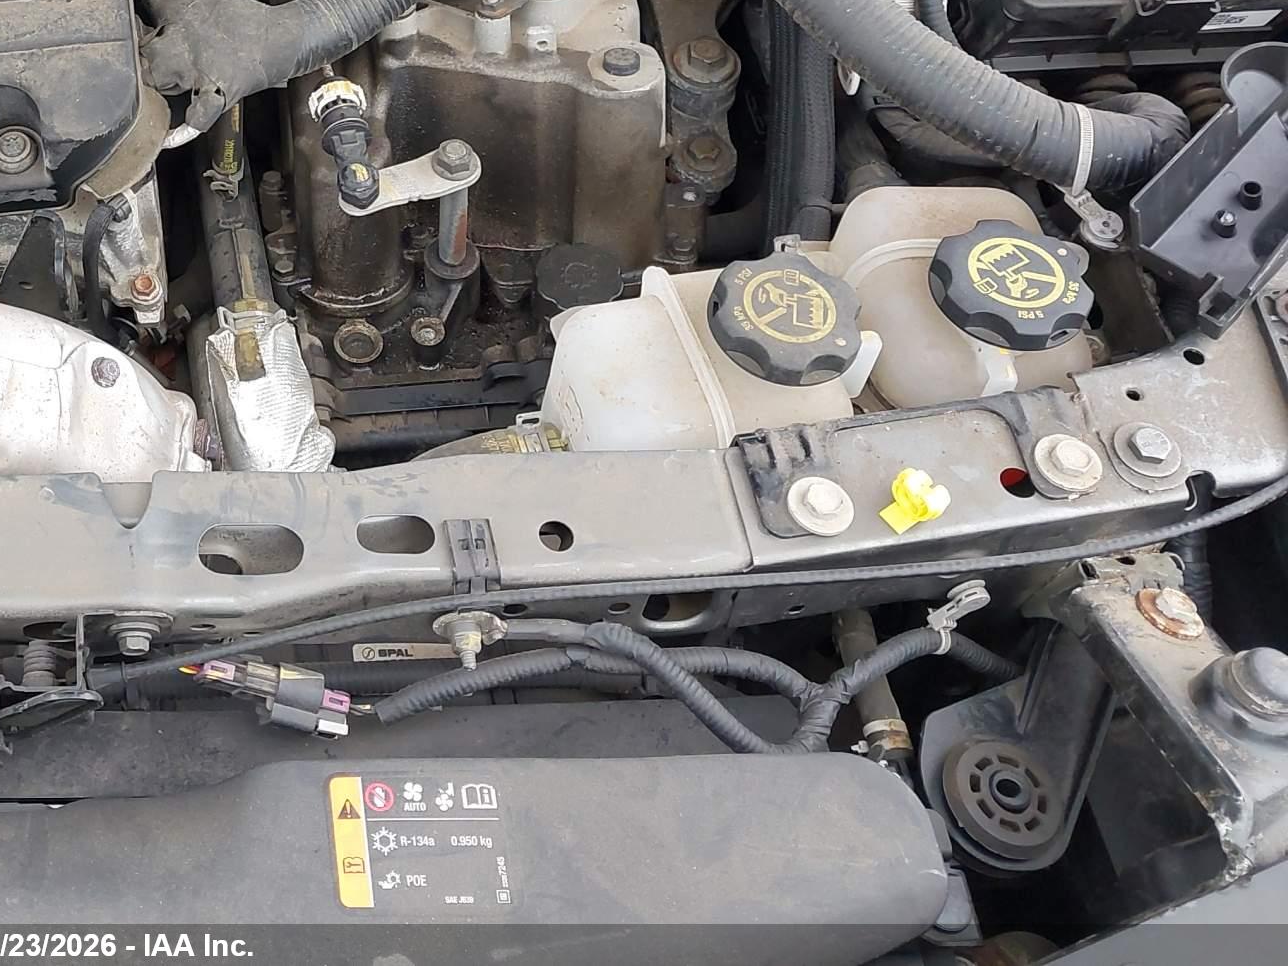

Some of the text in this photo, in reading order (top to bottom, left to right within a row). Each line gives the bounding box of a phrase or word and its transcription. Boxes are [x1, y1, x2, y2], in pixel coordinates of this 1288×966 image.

[737, 267, 753, 281] PSI
[1017, 310, 1045, 320] 5 PSI
[377, 648, 414, 658] SPAL
[403, 802, 427, 812] AUTO
[400, 835, 493, 849] R-134a 0.950 kg
[405, 874, 428, 887] POE
